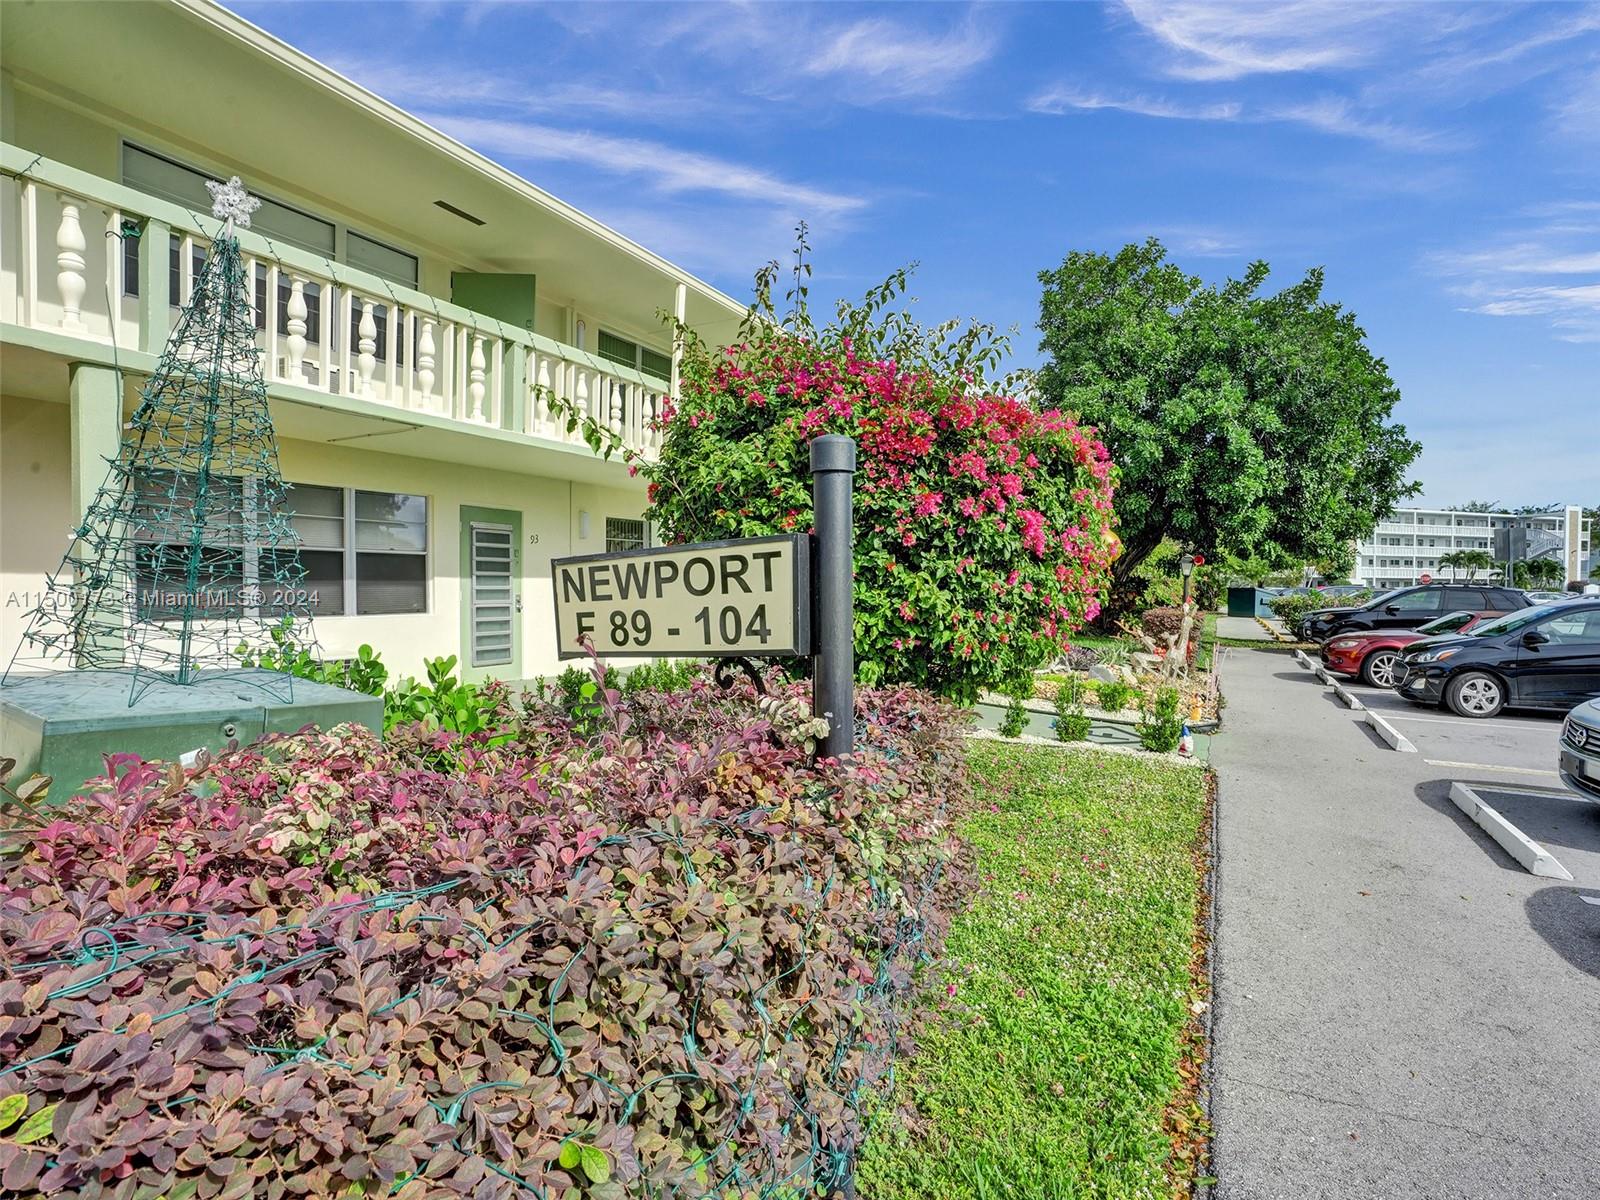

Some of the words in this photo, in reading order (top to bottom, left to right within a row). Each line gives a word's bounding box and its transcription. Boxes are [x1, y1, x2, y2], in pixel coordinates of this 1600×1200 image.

[530, 534, 539, 545] 93
[561, 551, 782, 603] NEWPORT
[576, 612, 595, 645] F
[610, 610, 652, 647] 89
[694, 604, 771, 645] 104
